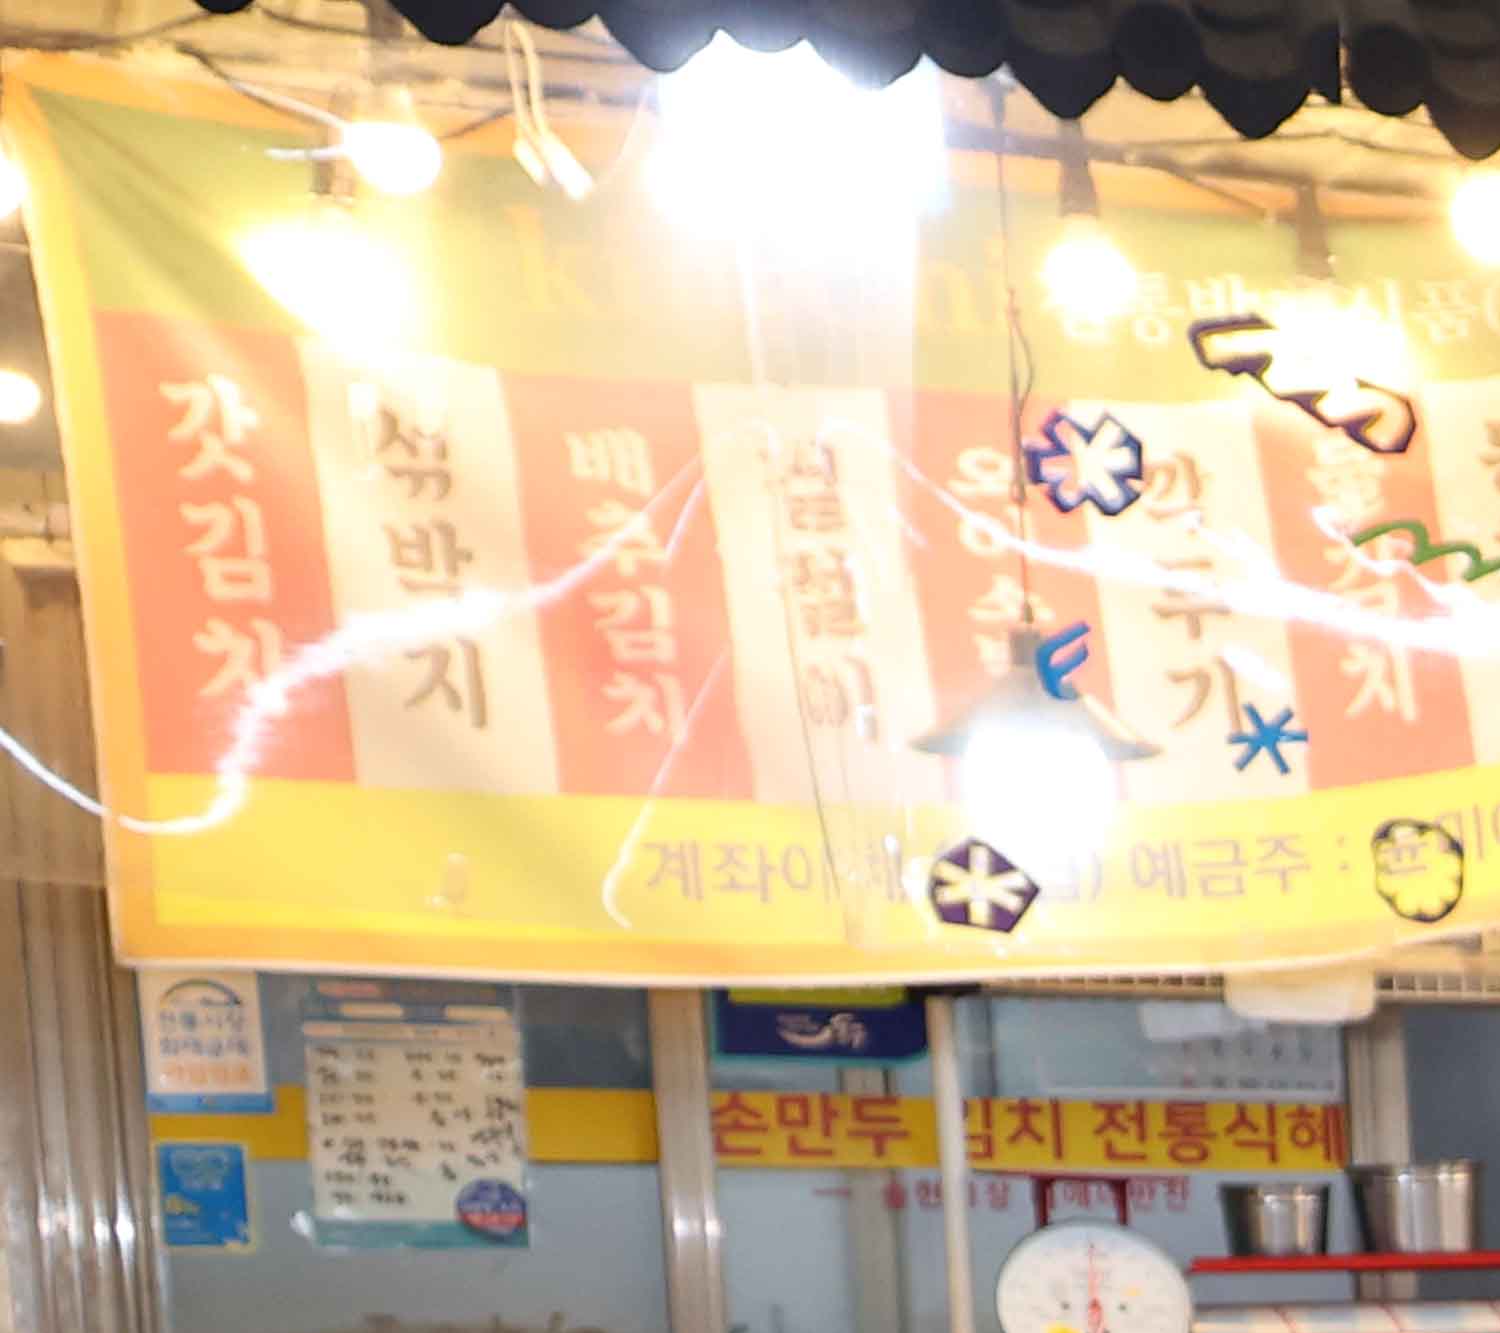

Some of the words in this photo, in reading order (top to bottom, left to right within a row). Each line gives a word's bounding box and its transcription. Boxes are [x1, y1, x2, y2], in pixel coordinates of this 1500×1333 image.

[157, 376, 288, 702] 갓김치
[372, 405, 492, 732] 섞박지
[568, 426, 690, 748] 배추김치
[1128, 834, 1308, 906] 예금주
[713, 1092, 911, 1160] 손만두
[1093, 1100, 1350, 1167] 전통식혜
